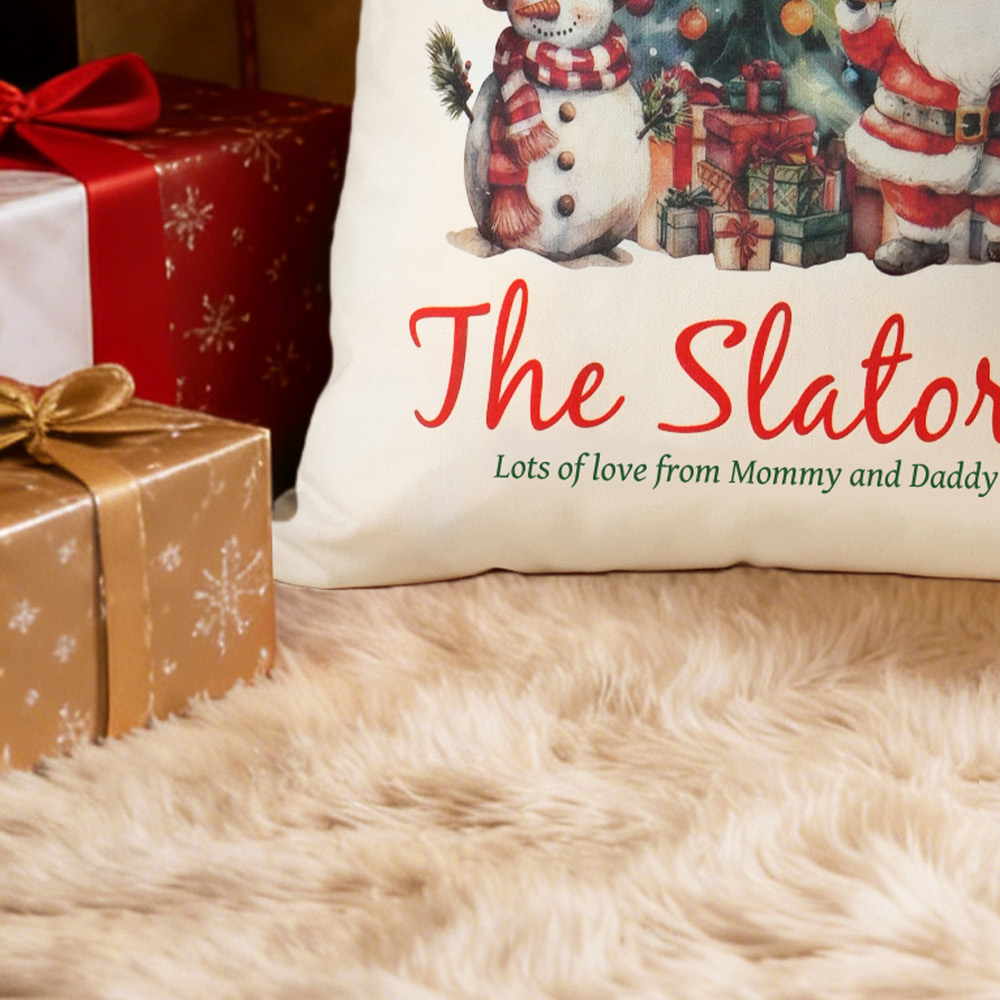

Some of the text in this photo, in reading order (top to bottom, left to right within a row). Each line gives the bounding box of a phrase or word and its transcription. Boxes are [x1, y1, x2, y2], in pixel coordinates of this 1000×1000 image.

[408, 278, 626, 431] The
[493, 452, 999, 498] Lots of love from Mommy and Daddy
